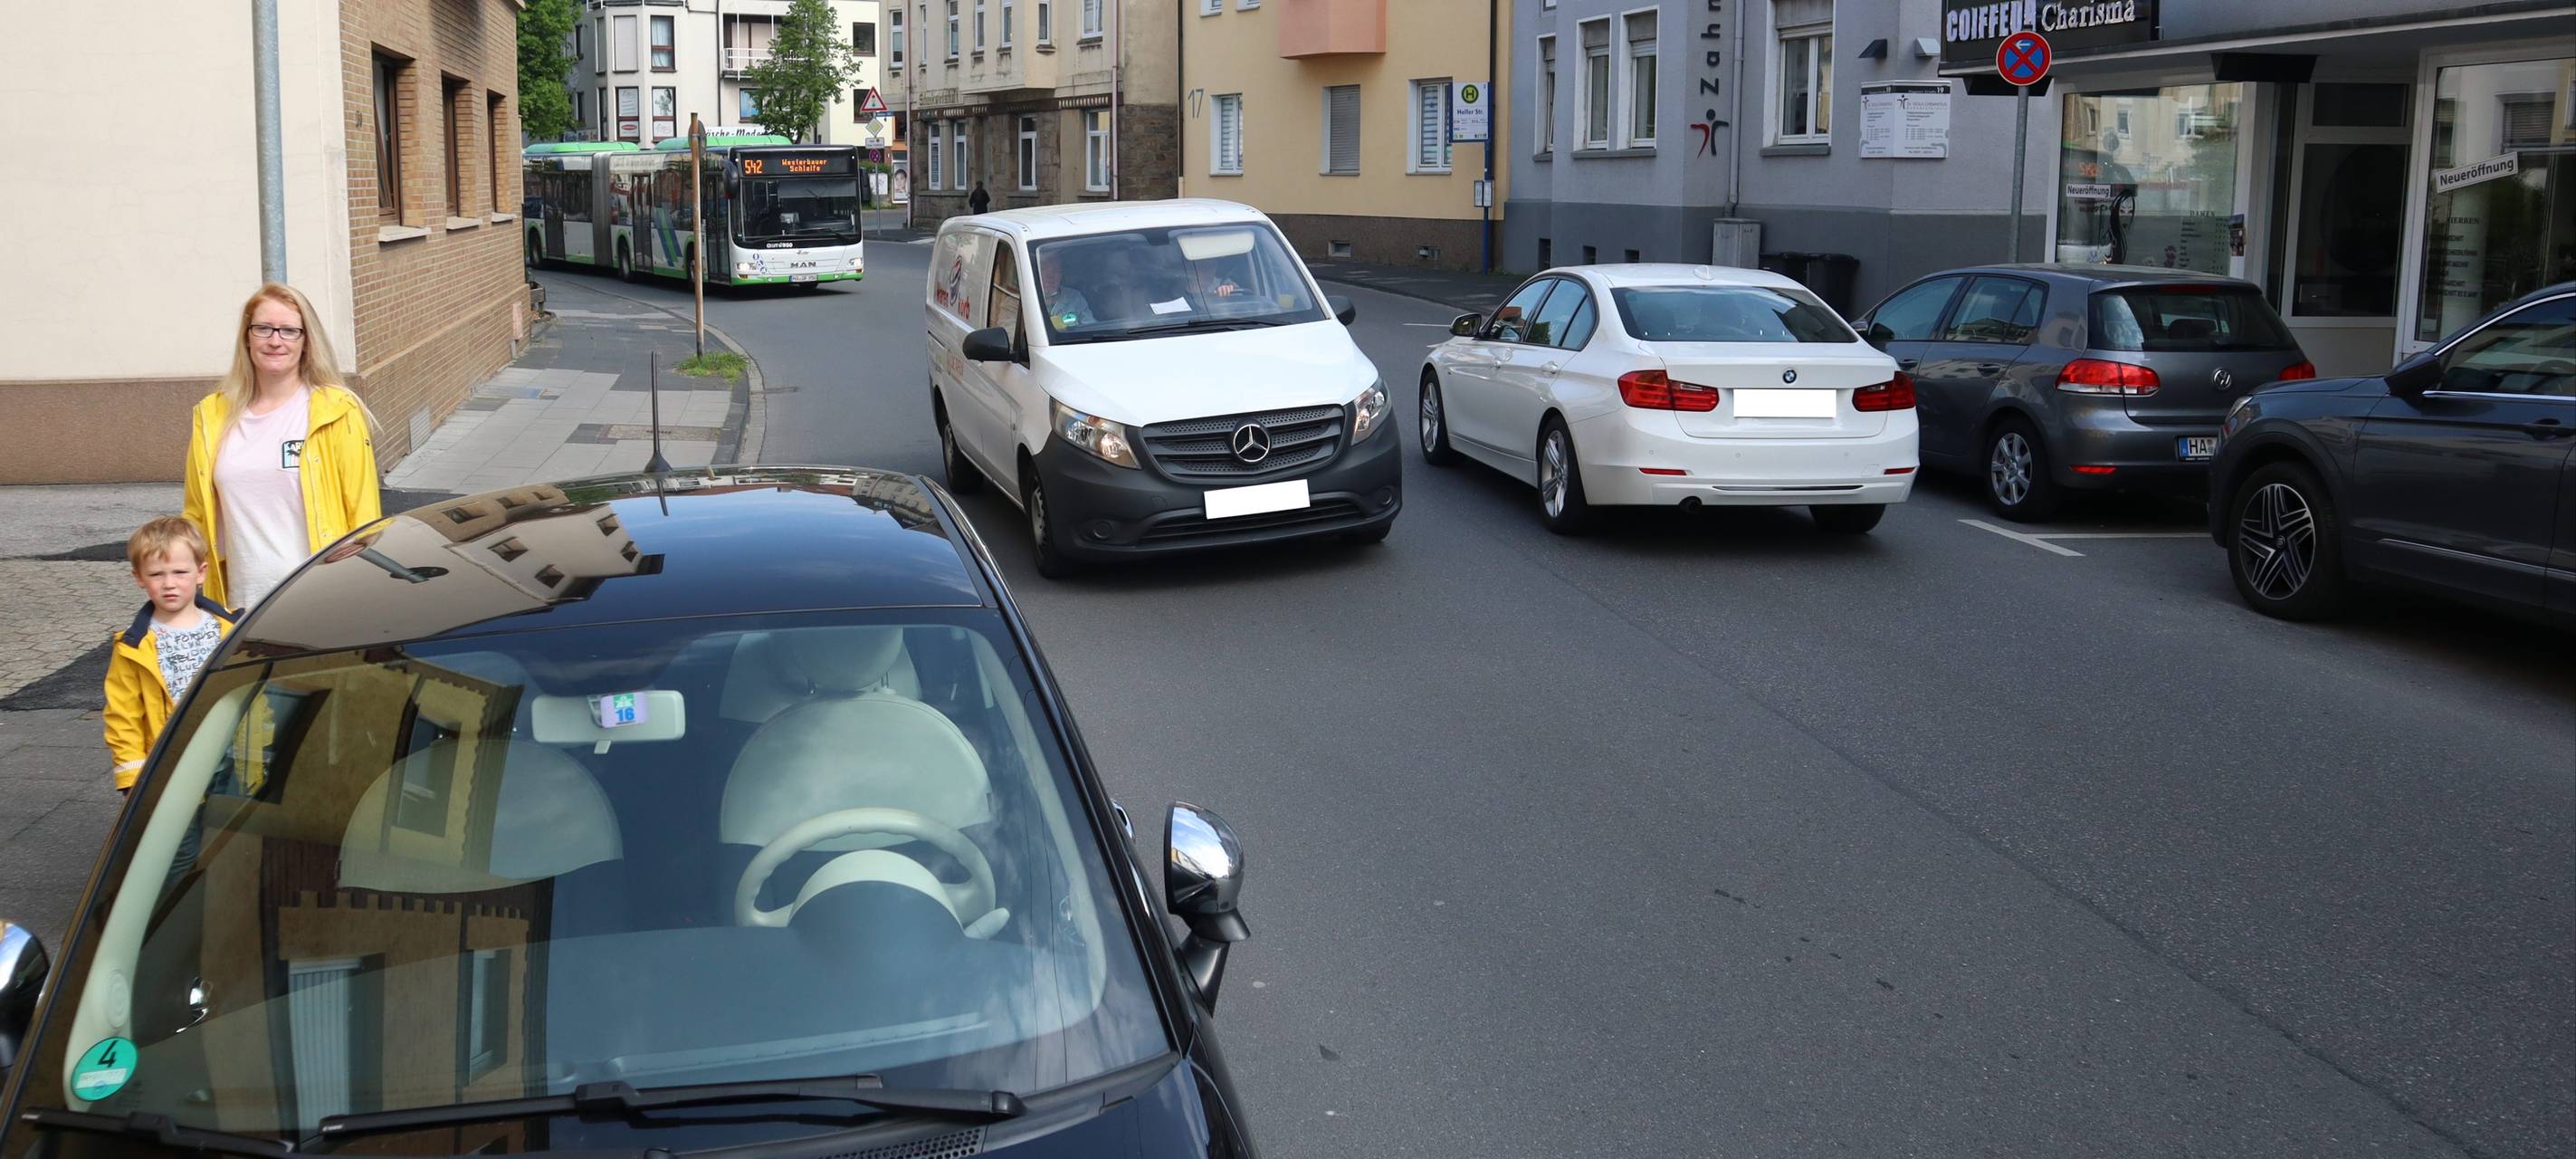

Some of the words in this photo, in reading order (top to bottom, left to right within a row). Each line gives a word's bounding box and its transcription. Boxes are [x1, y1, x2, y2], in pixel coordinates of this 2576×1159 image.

[1947, 0, 2037, 42] COIFFEUR
[2041, 0, 2136, 32] Charisma
[1188, 88, 1204, 119] 17
[744, 159, 763, 174] 542
[2440, 159, 2514, 186] Neueröffnung
[2067, 186, 2110, 196] Neueröffnung
[2189, 437, 2208, 455] HA
[615, 709, 634, 722] 16
[97, 1039, 119, 1068] 4
